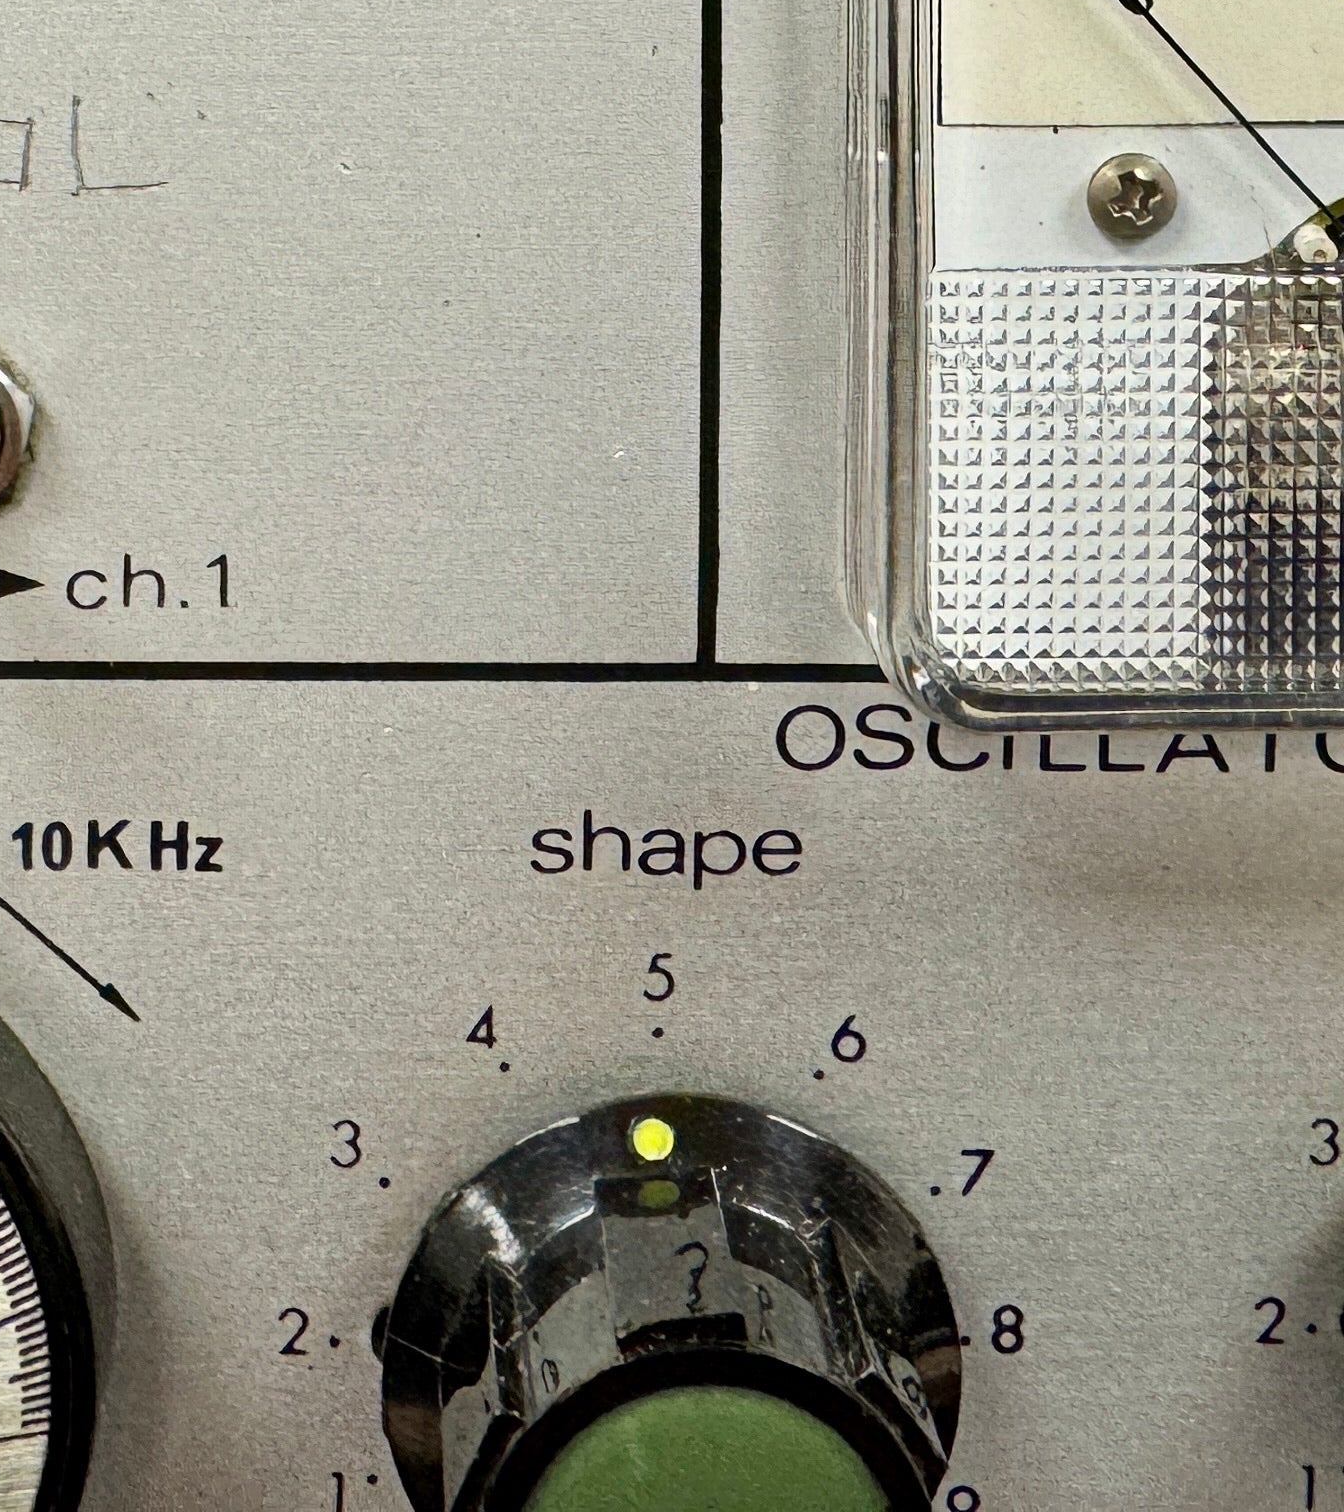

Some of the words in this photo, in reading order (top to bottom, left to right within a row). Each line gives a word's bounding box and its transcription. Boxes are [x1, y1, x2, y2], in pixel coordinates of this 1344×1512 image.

[66, 552, 233, 610] ch.1
[530, 809, 803, 891] shape
[278, 1307, 310, 1356] 2
[329, 1119, 362, 1169] 3
[465, 1004, 498, 1049] 4
[642, 952, 675, 1002] 5
[830, 1014, 867, 1063] 6
[960, 1148, 995, 1197] 7
[990, 1303, 1025, 1355] 8
[1254, 1296, 1287, 1345] 2
[1309, 1118, 1341, 1167] 3
